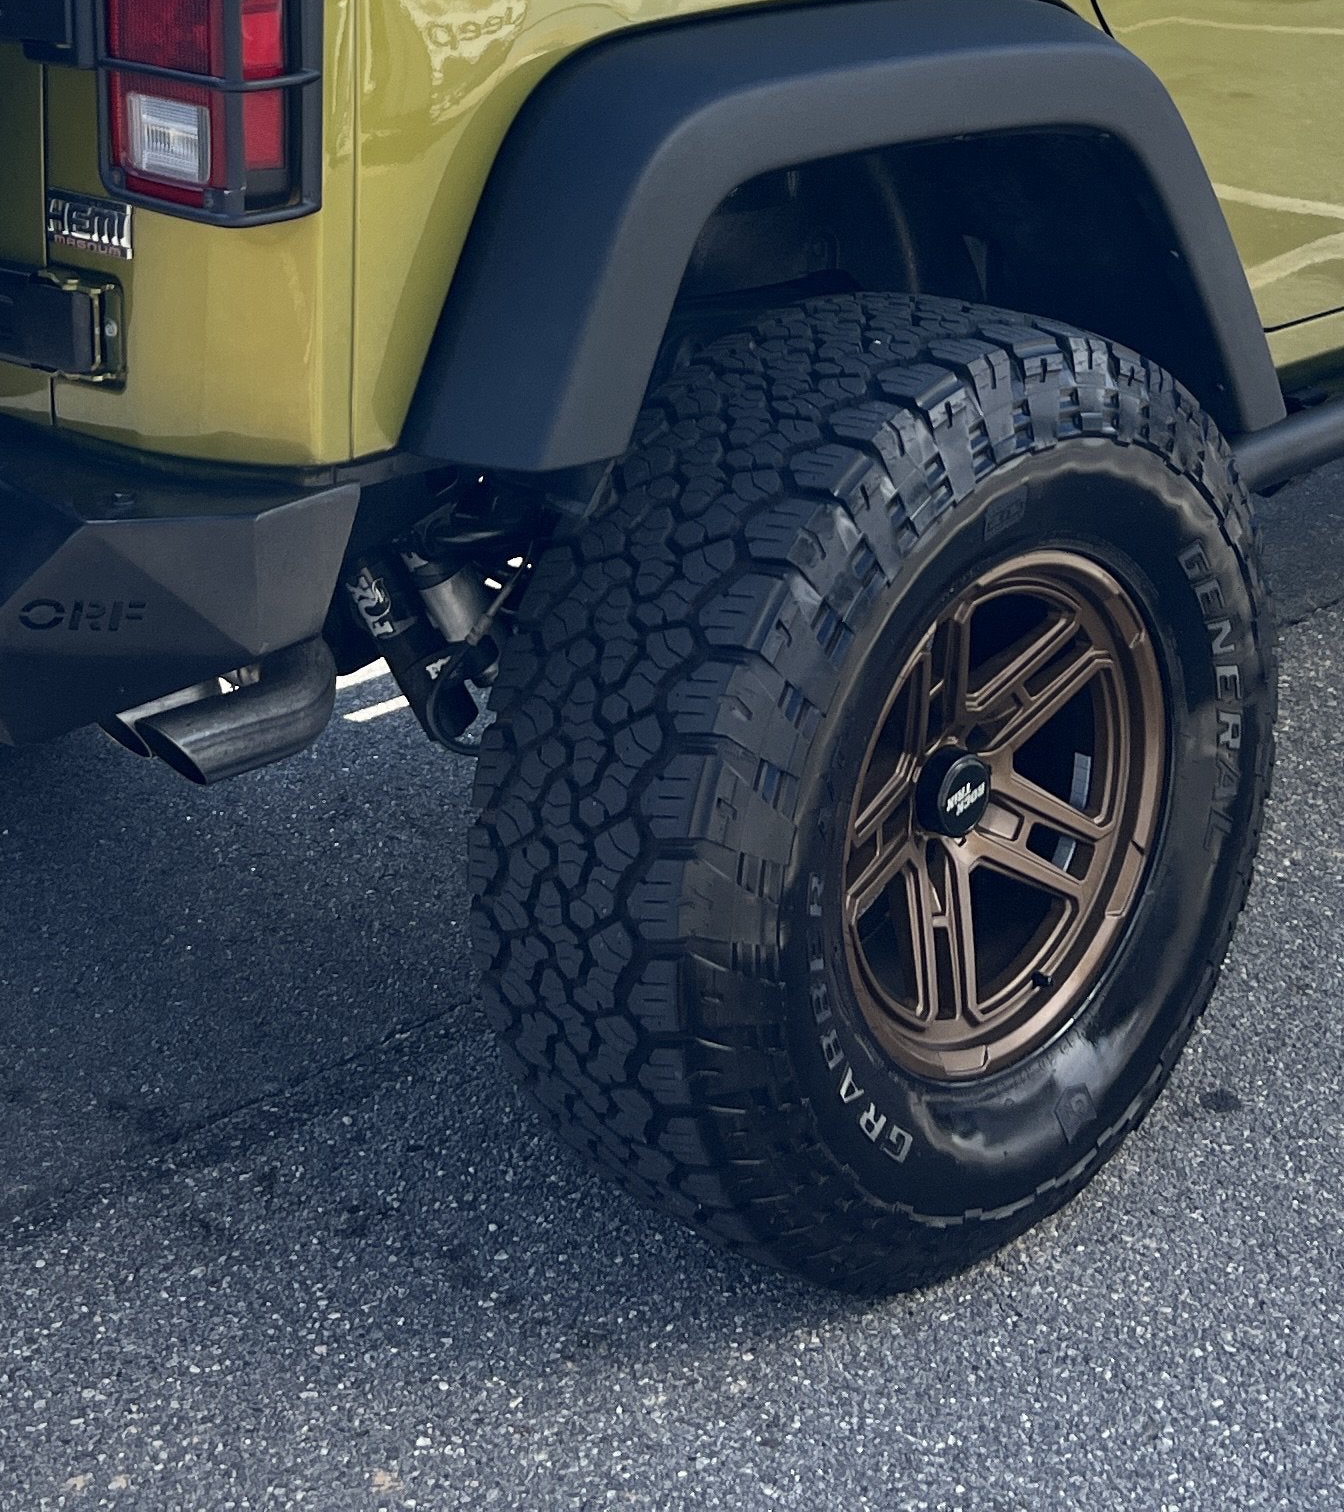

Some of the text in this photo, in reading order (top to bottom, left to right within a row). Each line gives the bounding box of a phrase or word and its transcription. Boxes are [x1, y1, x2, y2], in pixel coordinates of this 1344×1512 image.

[48, 197, 131, 249] HEMI
[19, 599, 146, 631] ORF
[1177, 538, 1242, 858] GENERAL
[808, 872, 914, 1163] GRABBER
